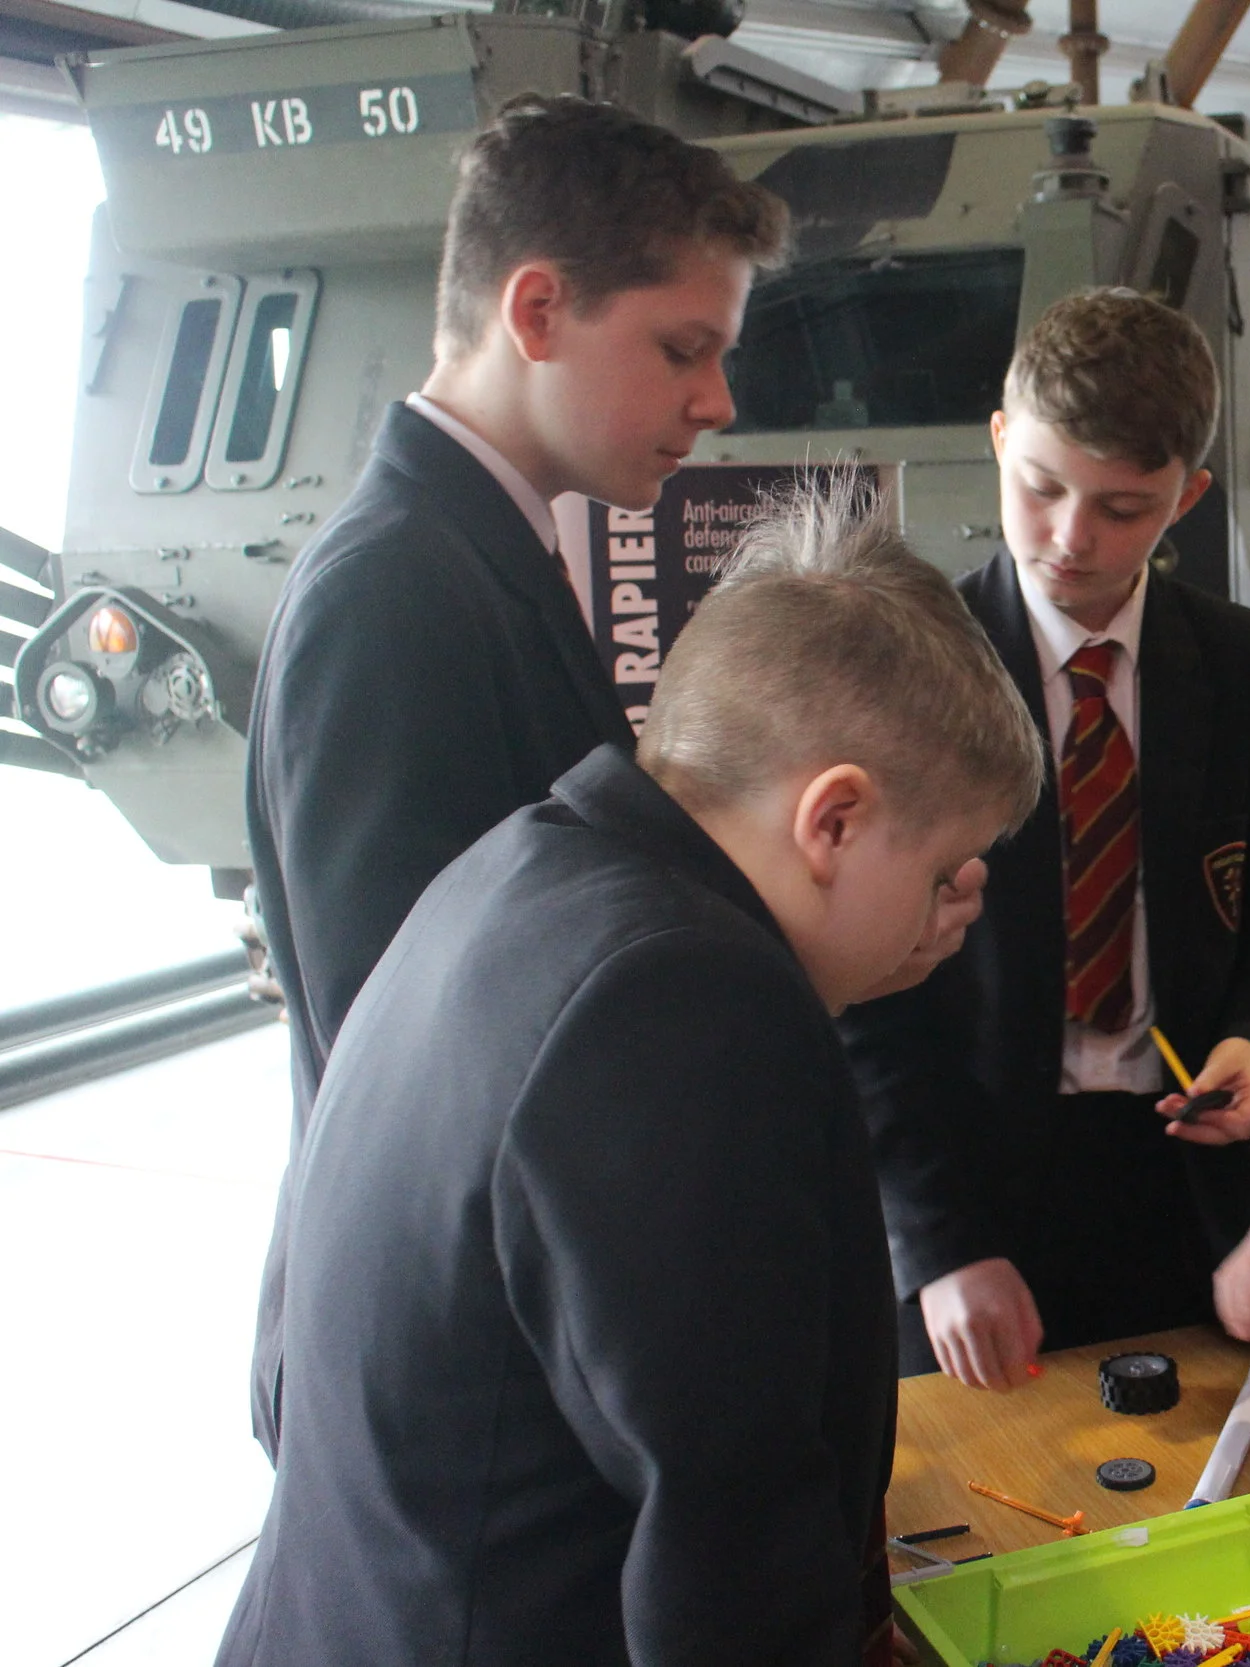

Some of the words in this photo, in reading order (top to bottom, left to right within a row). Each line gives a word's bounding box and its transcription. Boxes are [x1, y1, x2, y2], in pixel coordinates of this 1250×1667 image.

[155, 107, 213, 154] 49
[251, 97, 313, 148] KB
[359, 86, 419, 137] 50
[607, 506, 661, 685] RAPIER
